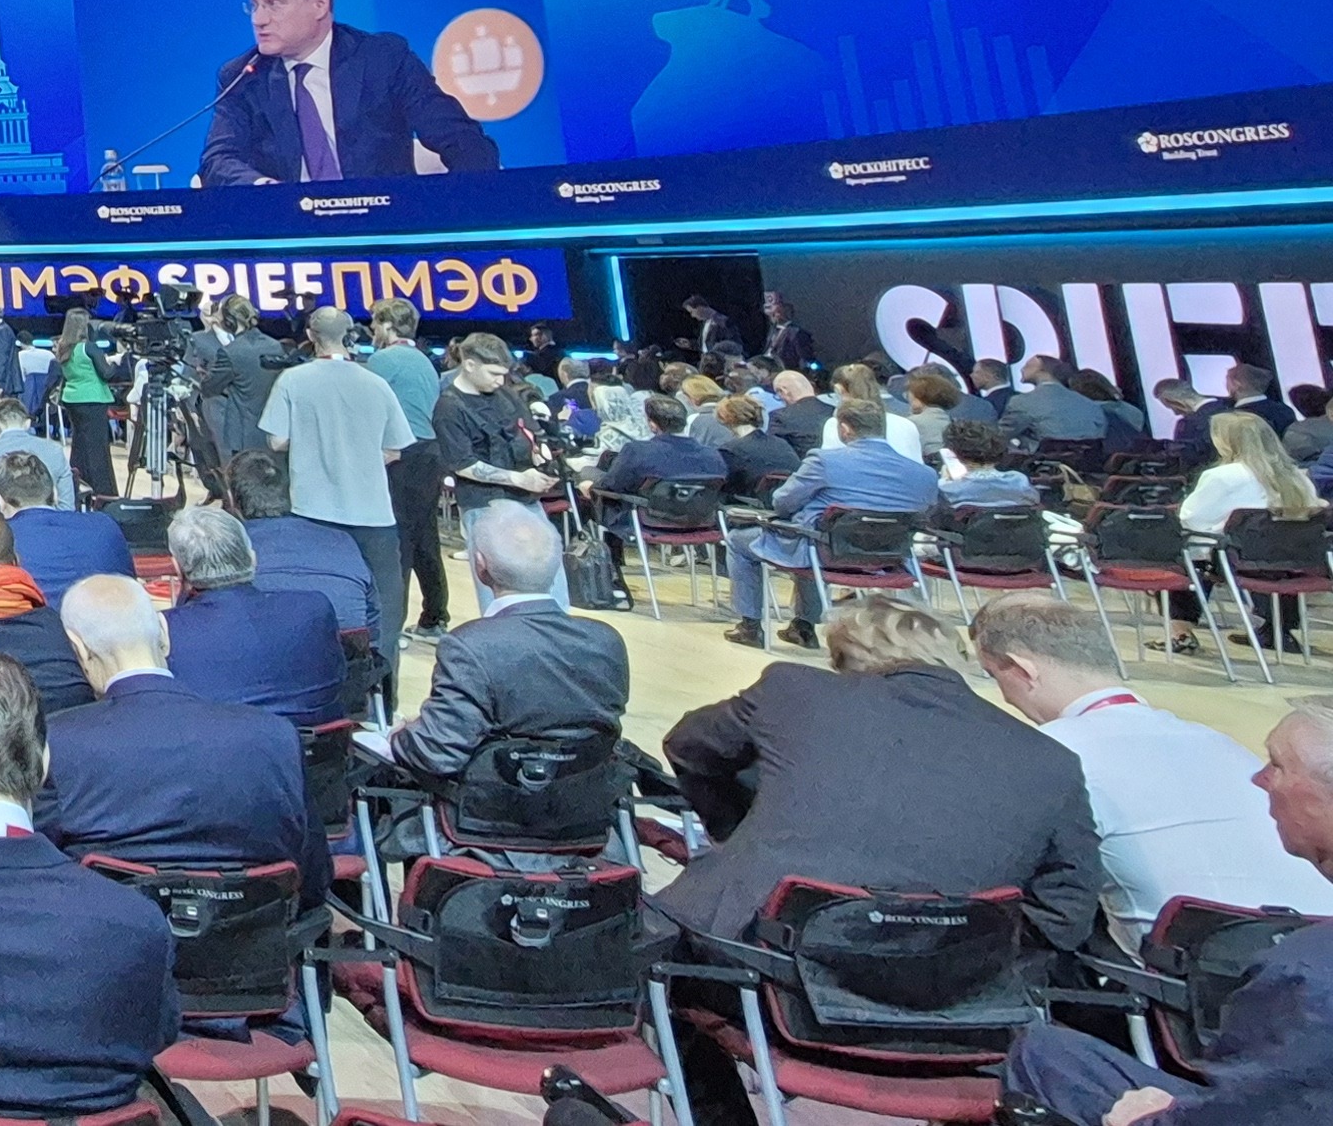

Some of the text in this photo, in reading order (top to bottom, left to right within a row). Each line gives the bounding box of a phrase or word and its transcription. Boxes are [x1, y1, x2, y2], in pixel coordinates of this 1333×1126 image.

[1157, 122, 1290, 149] ROSCONGRESS
[843, 157, 930, 176] РОСКОНГРЕСС
[574, 179, 661, 194] ROSCONGRESS
[330, 257, 538, 313] ПМЭФ
